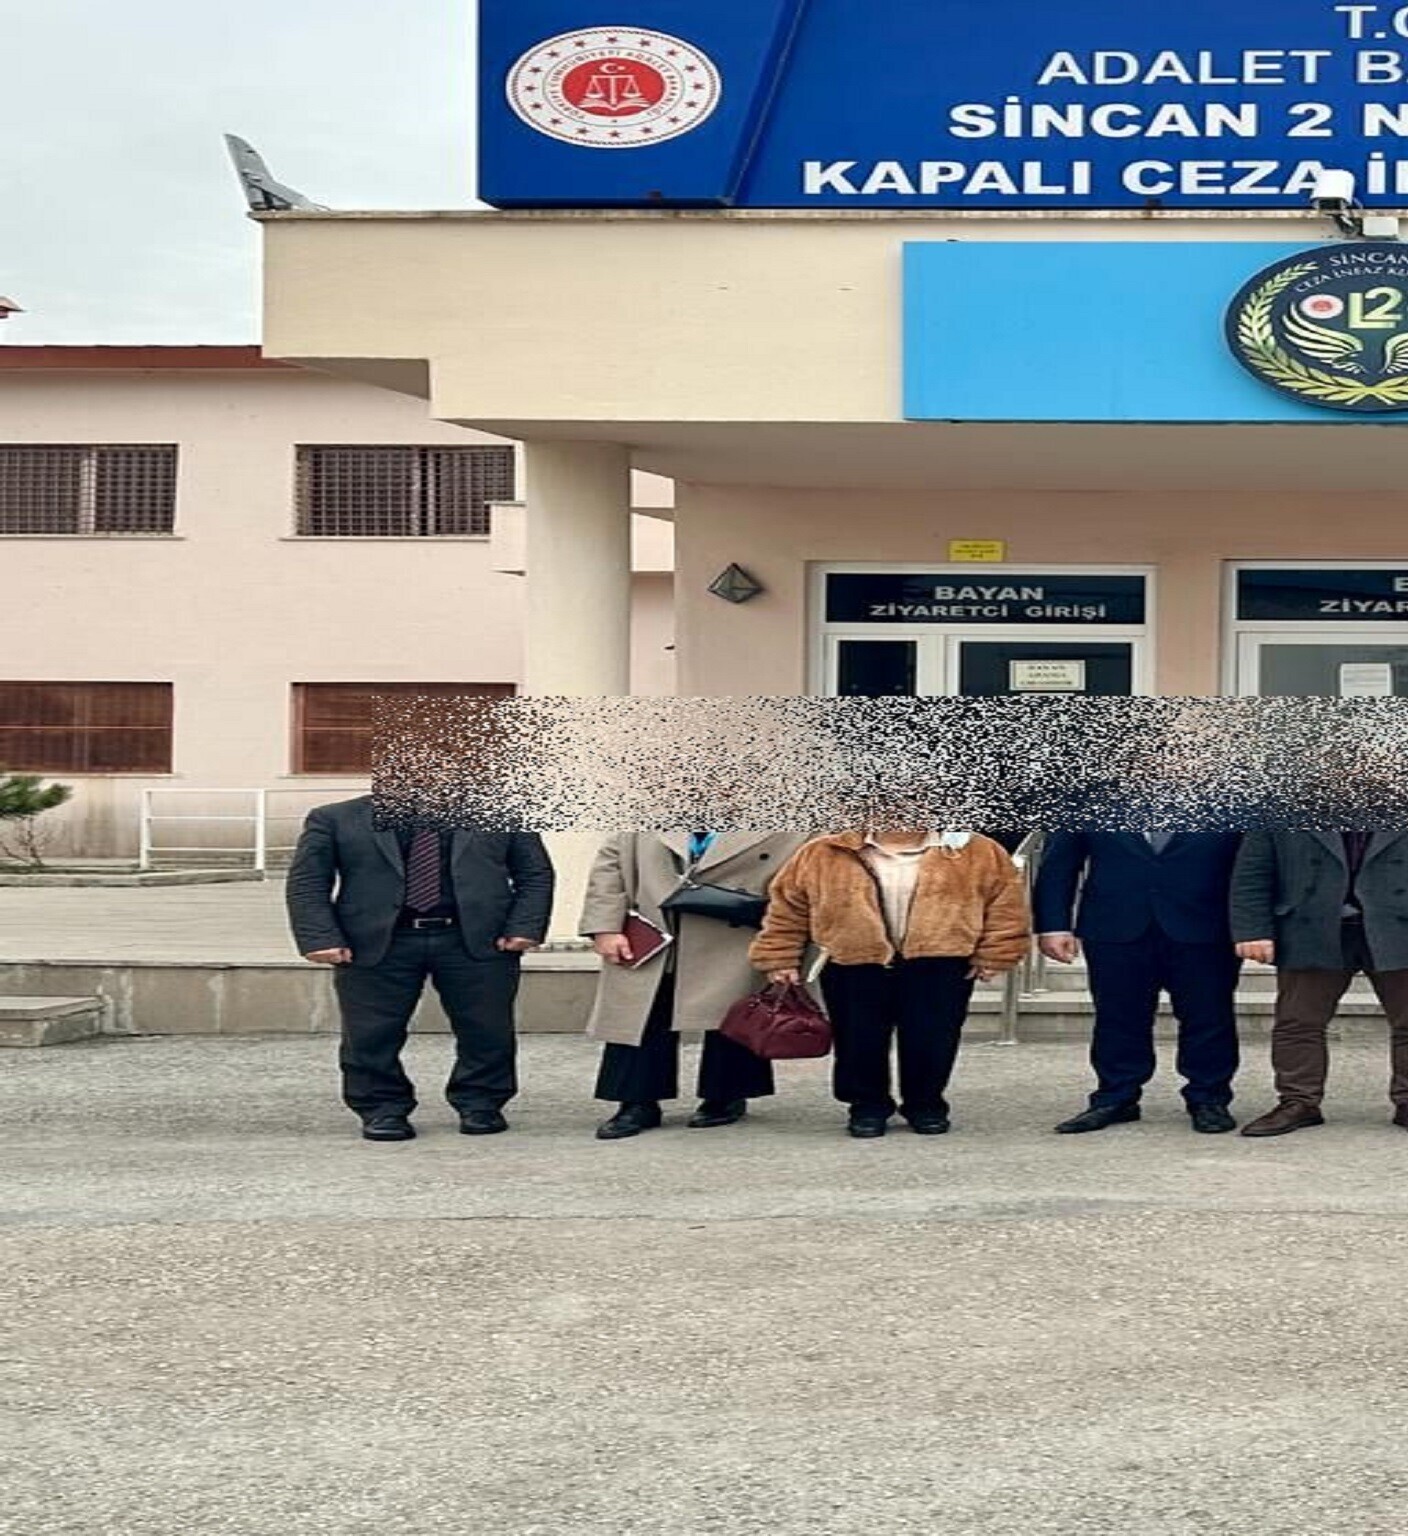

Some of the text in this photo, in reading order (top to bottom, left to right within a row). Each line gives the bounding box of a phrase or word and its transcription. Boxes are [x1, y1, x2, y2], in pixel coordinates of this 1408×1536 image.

[1037, 50, 1332, 85] ADALET
[949, 96, 1257, 138] SİNCAN
[1287, 103, 1332, 136] 2
[804, 161, 1090, 195] KAPALI
[1122, 160, 1326, 196] CEZA
[934, 585, 1043, 600] BAYAN
[1025, 604, 1106, 620] GİRİŞİ
